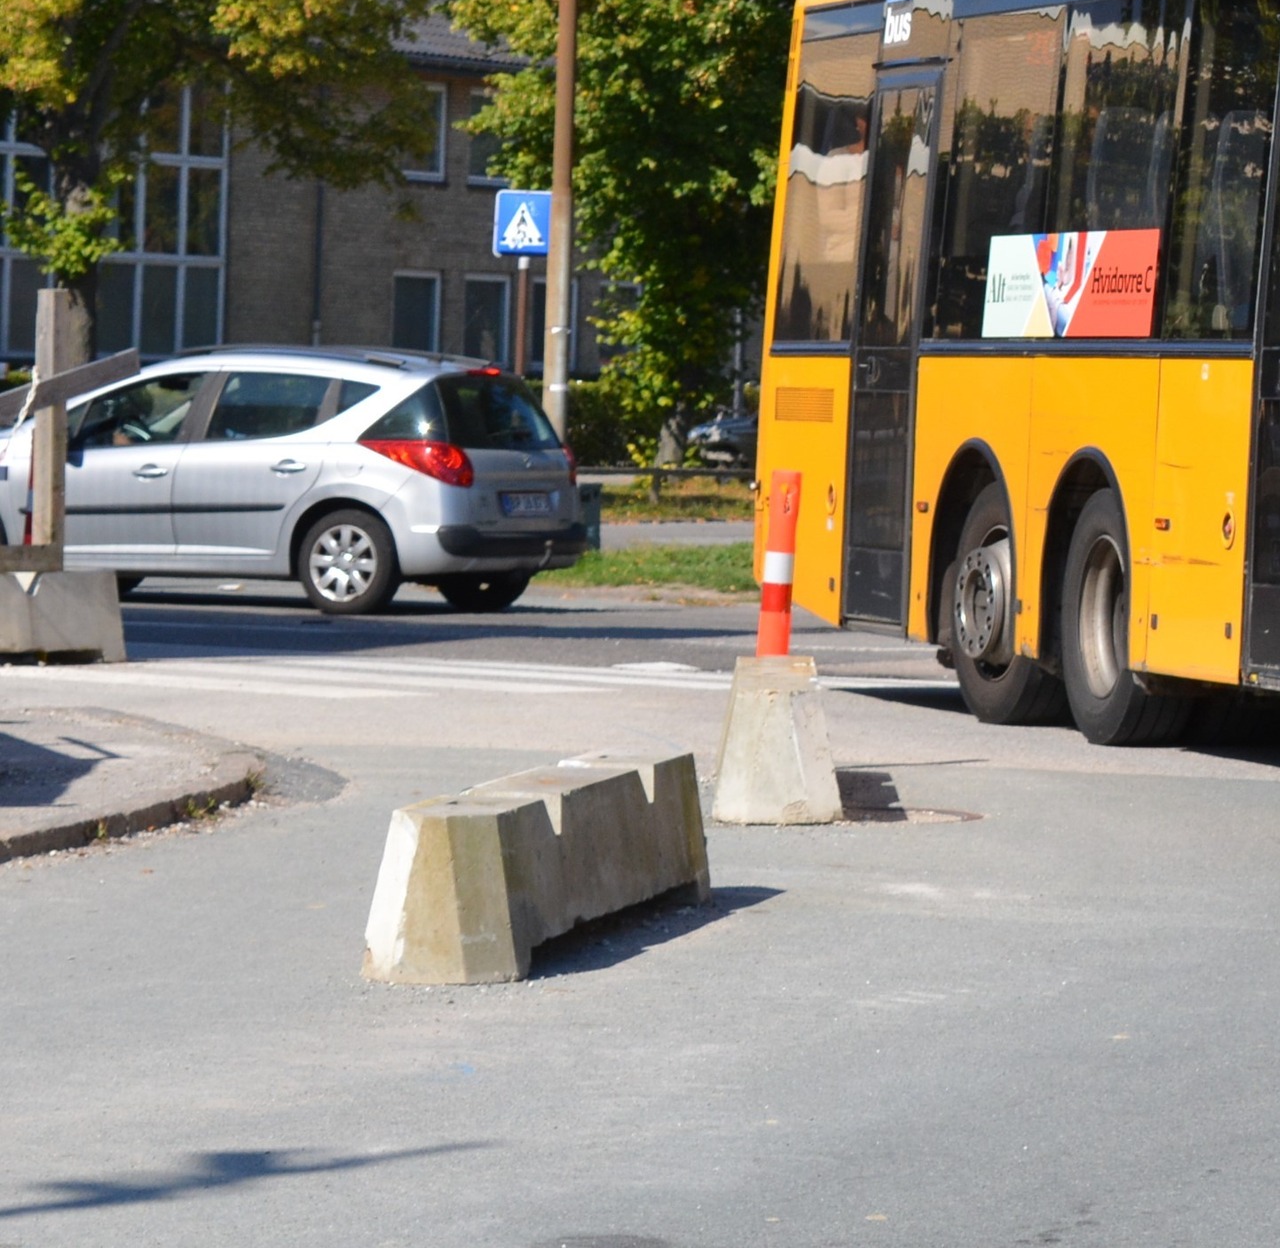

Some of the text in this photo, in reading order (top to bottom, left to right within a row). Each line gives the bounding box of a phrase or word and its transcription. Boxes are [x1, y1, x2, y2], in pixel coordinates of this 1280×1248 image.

[883, 6, 912, 45] bus
[987, 272, 1007, 304] Alt
[1091, 265, 1154, 295] Hvidovre C
